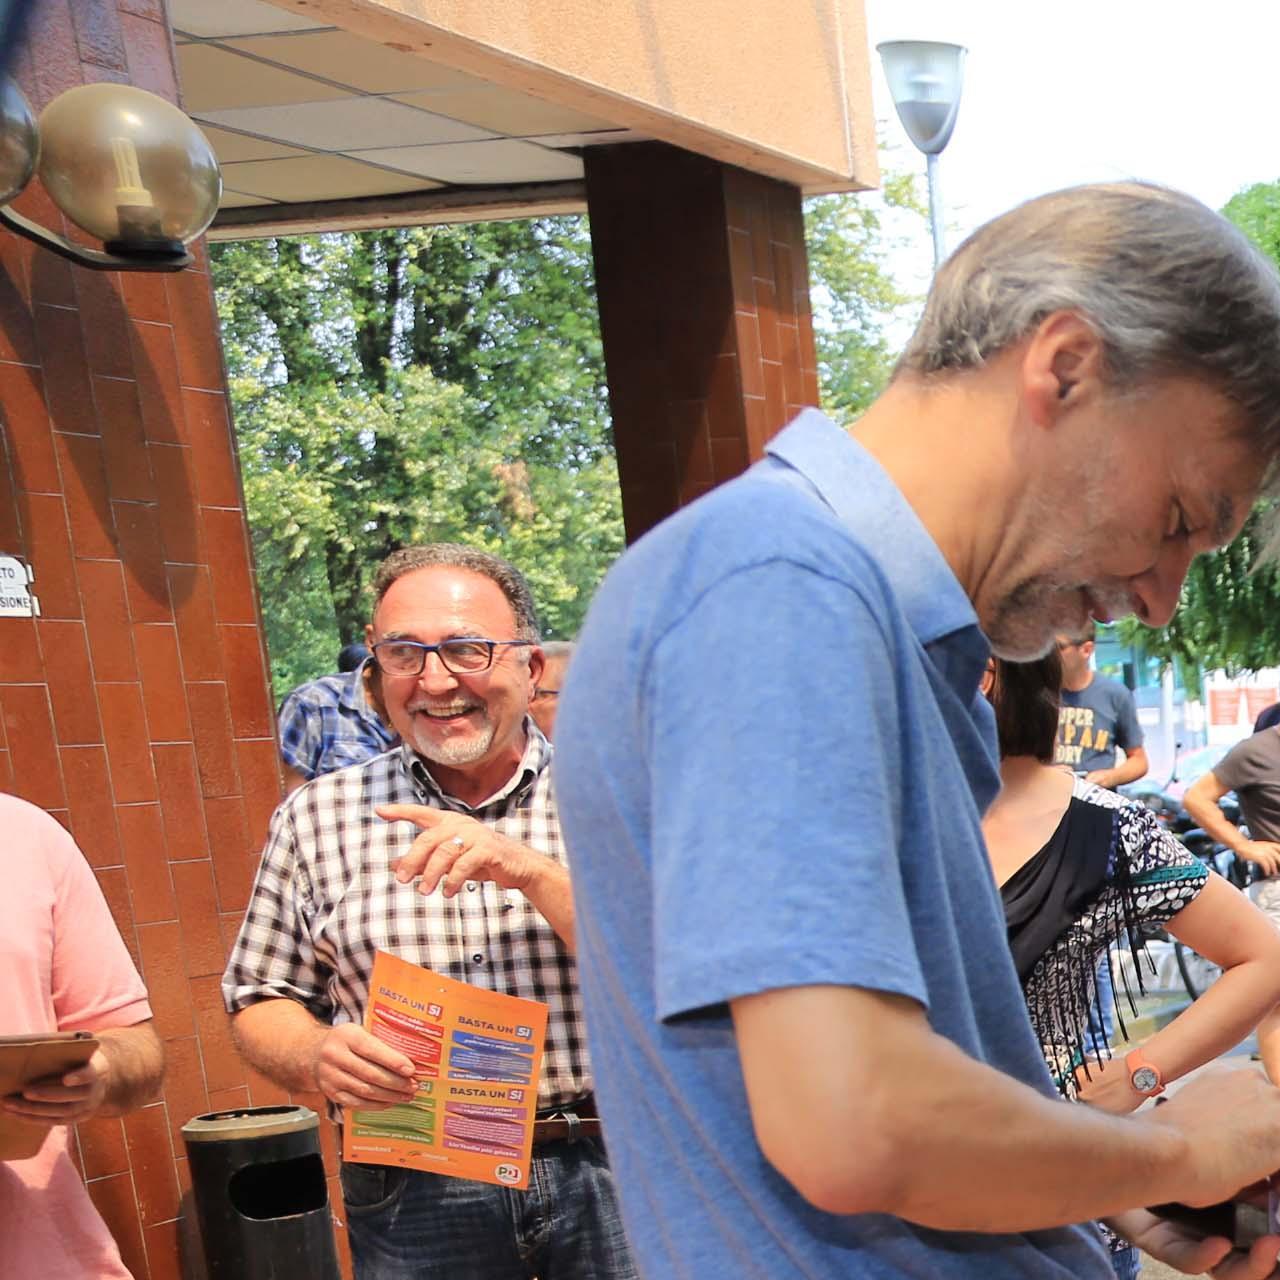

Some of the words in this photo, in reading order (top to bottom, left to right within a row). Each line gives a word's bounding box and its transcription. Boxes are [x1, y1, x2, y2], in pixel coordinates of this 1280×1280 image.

[0, 568, 15, 578] TO
[0, 597, 30, 608] SIONE
[1058, 707, 1094, 726] UPER
[1056, 727, 1109, 752] PAN
[1056, 744, 1083, 763] DRY
[379, 987, 408, 1004] BASTA
[411, 1000, 425, 1011] UN
[458, 1016, 494, 1030] BASTA
[497, 1025, 513, 1034] UN
[450, 1087, 487, 1097] BASTA
